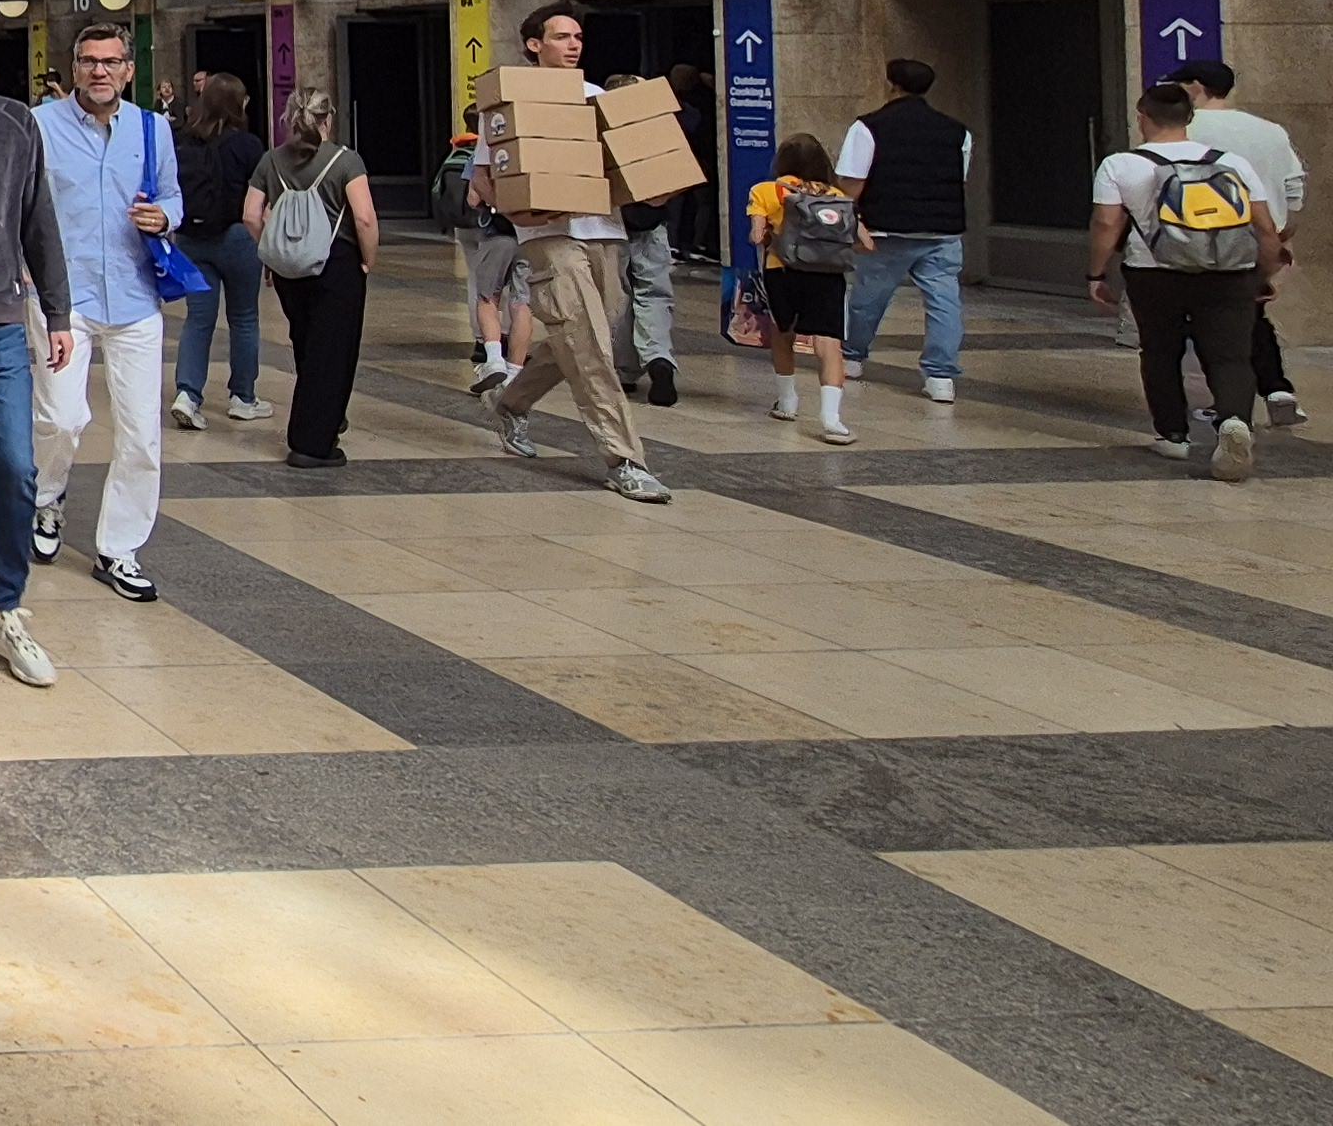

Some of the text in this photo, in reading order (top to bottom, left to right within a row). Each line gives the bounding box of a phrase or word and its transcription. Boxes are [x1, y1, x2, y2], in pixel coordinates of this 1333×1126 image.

[733, 76, 767, 86] Outdoor
[730, 87, 764, 98] Cooking
[730, 98, 772, 109] Gardening
[734, 128, 769, 137] Summer
